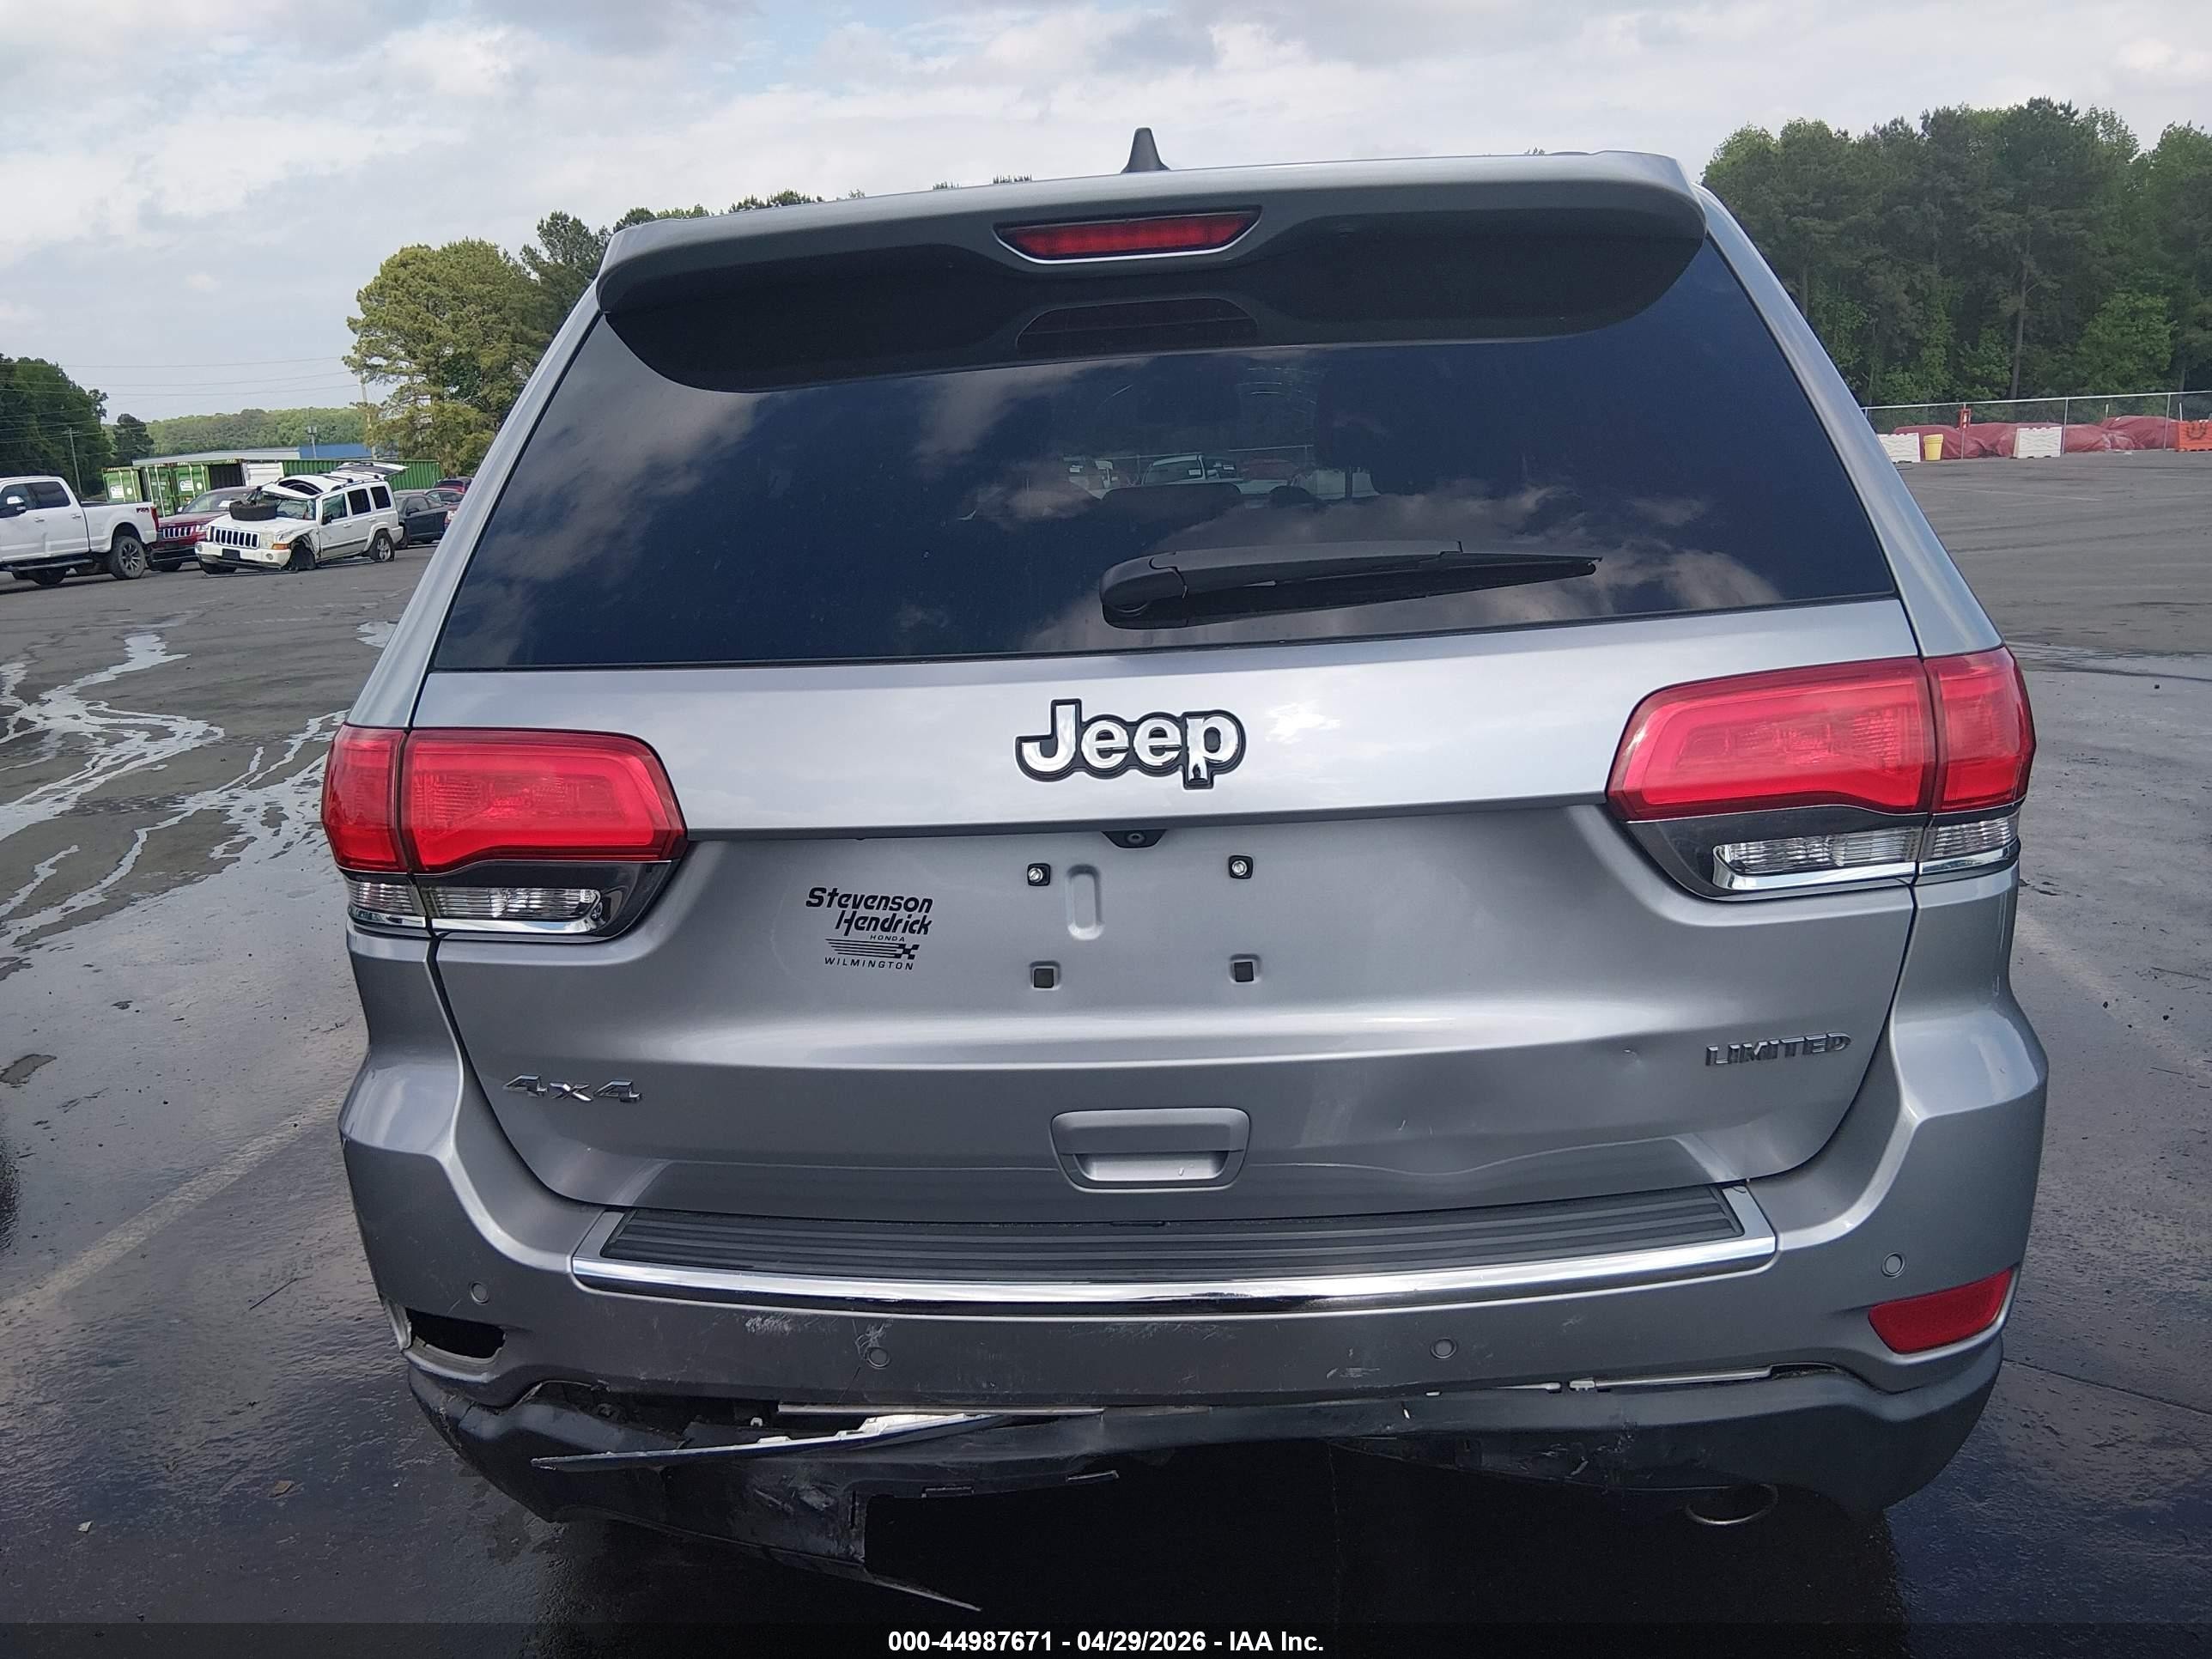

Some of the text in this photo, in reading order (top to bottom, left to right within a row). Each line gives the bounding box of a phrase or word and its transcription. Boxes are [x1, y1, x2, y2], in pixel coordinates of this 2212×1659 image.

[1015, 698, 1246, 790] Jeep
[805, 887, 933, 914] Stevenson
[835, 910, 932, 936] Hendrick
[824, 957, 914, 970] WILMINGTON
[1705, 1032, 1851, 1066] LIMITED
